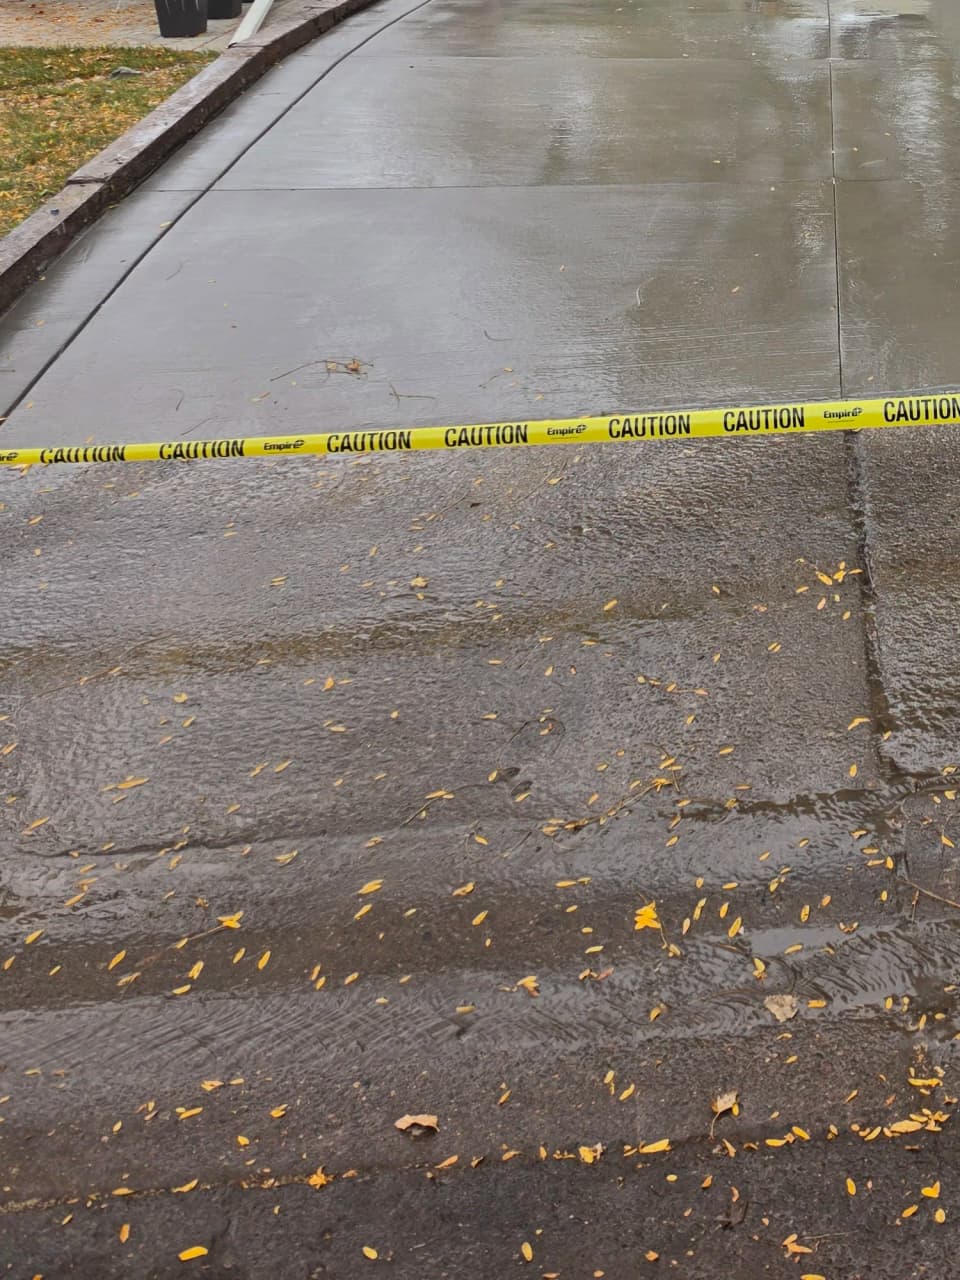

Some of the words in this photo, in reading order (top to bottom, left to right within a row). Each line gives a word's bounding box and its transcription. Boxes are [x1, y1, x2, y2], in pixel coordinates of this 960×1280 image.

[40, 446, 126, 464] CAUTION
[159, 440, 245, 460] CAUTION
[327, 431, 412, 452] CAUTION
[445, 424, 528, 447] CAUTION
[608, 415, 690, 438] CAUTION
[723, 408, 804, 432] CAUTION
